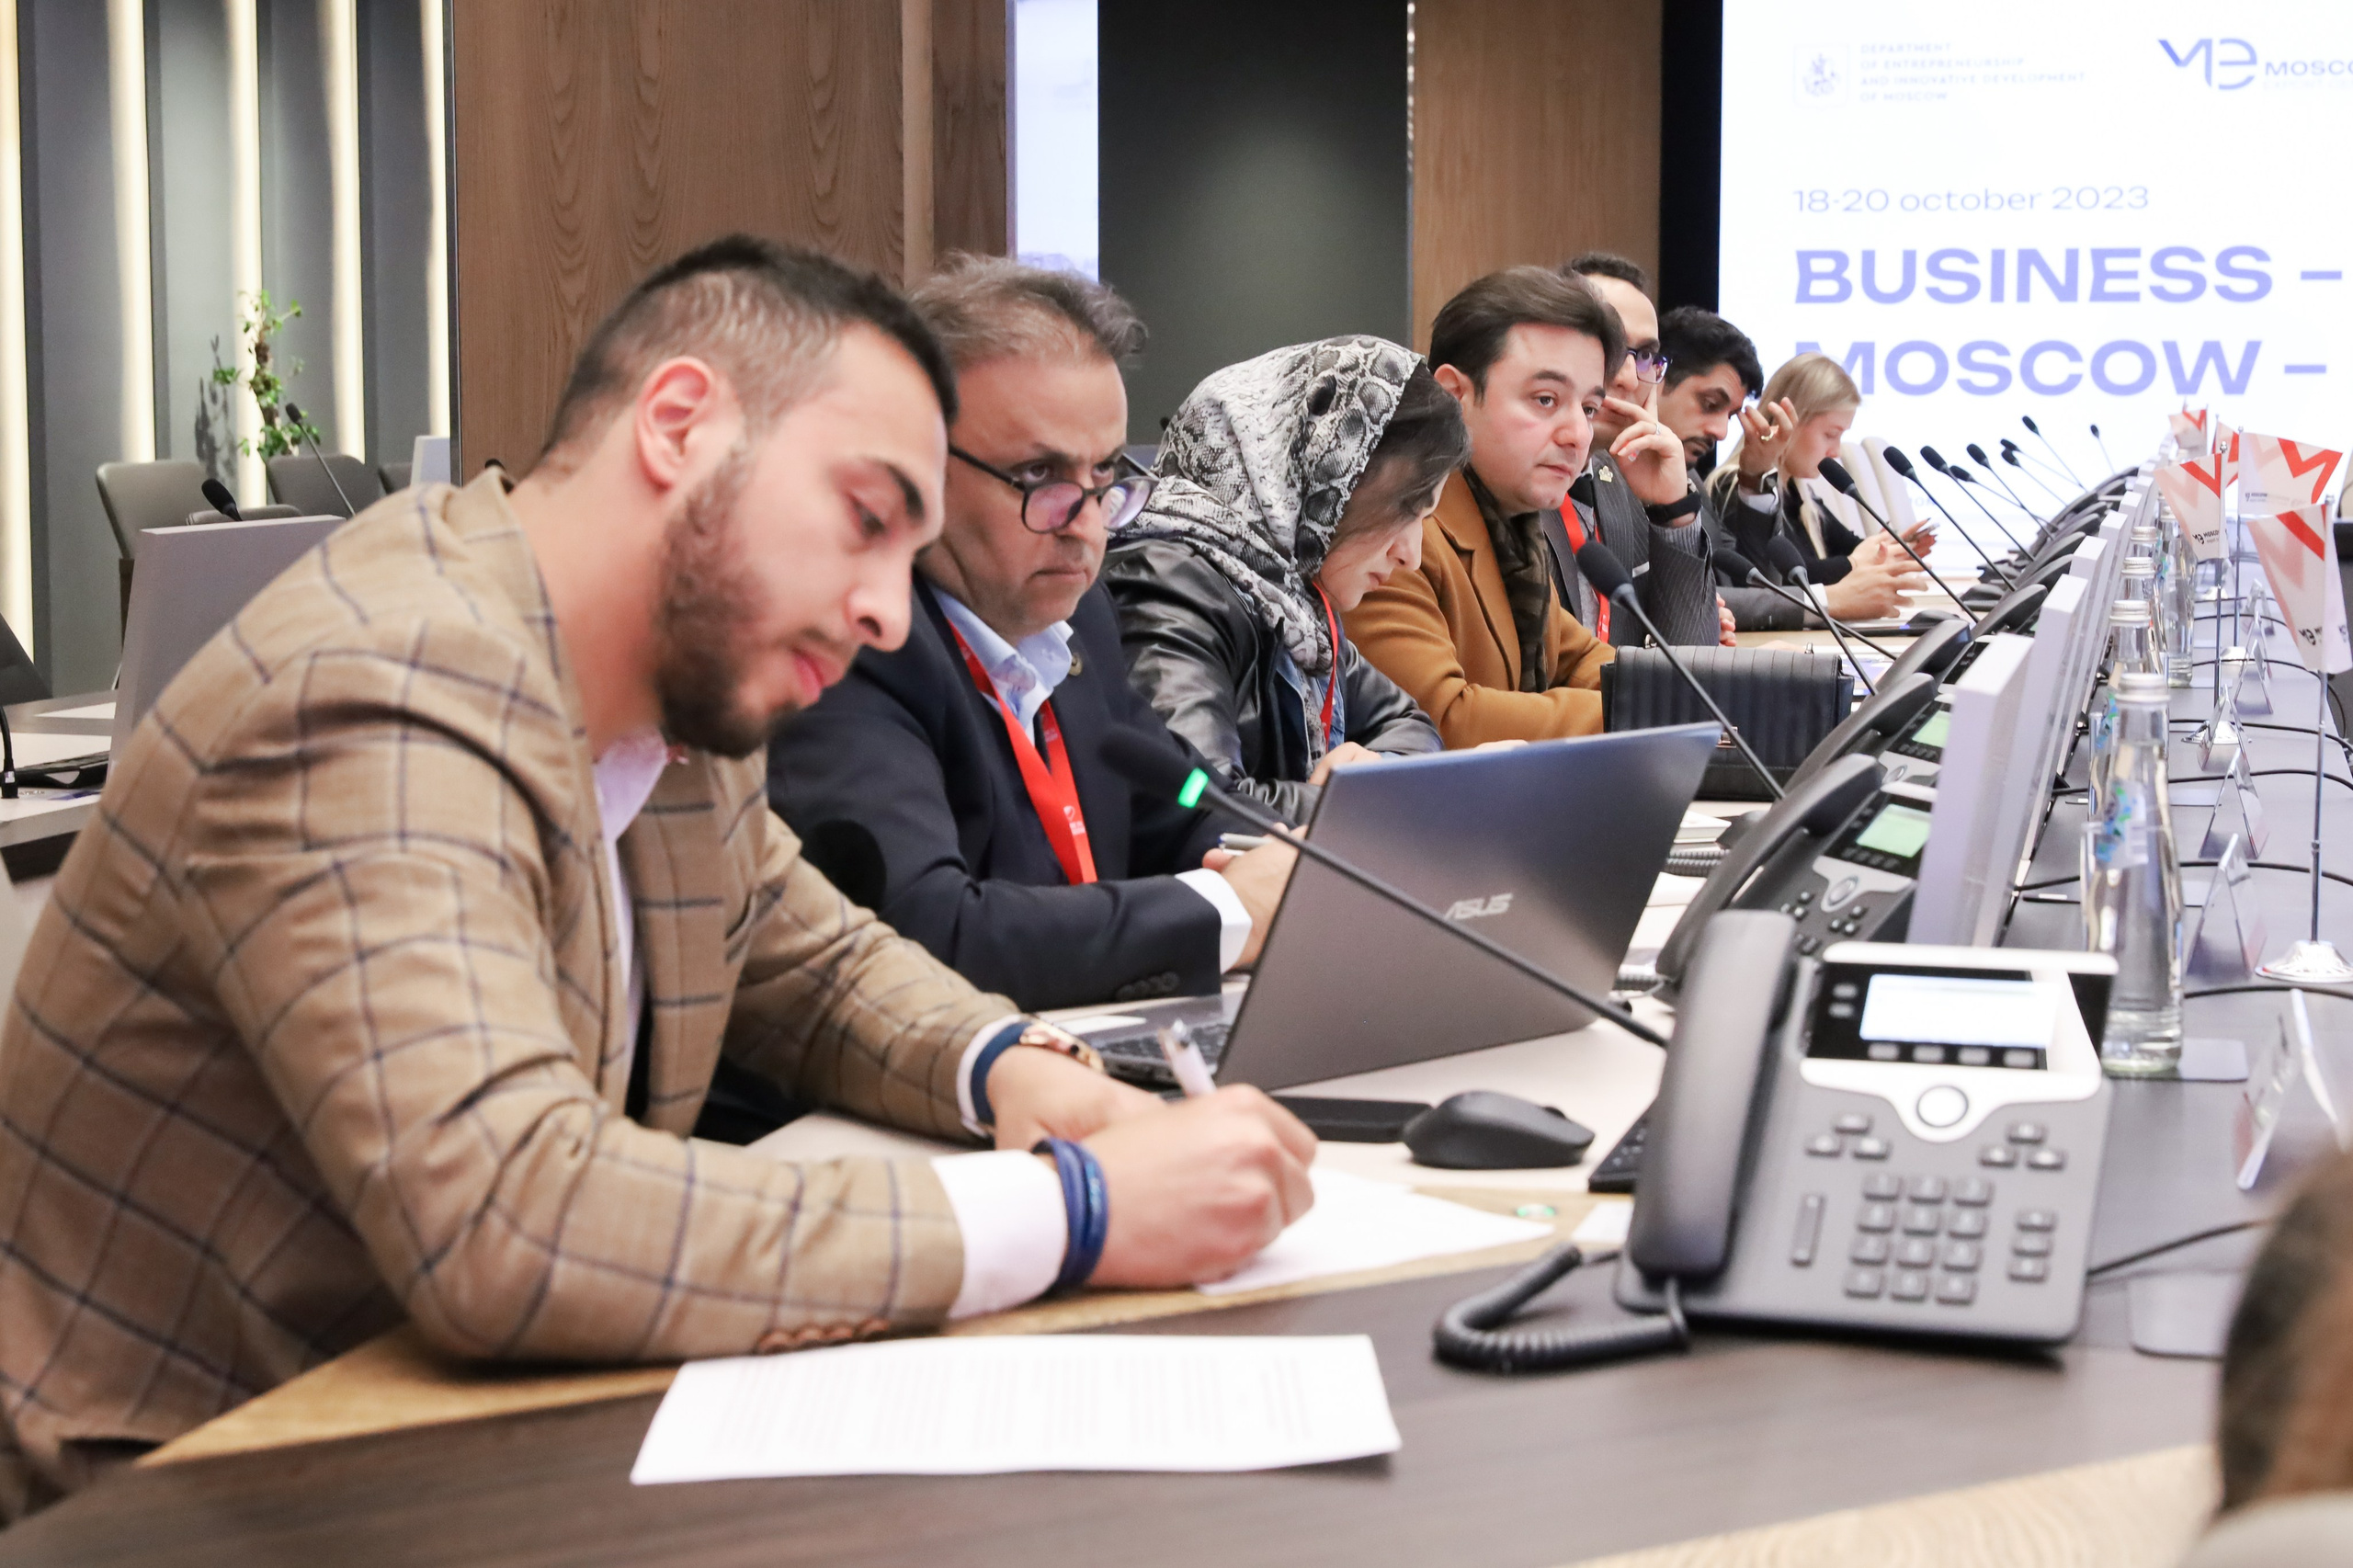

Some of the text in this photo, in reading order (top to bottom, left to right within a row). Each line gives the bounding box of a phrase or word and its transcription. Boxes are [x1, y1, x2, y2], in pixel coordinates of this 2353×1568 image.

[1859, 41, 1951, 54] DEPARTMENT
[1859, 59, 1877, 71] OF
[1859, 74, 1891, 86] AND
[1859, 90, 1948, 103] OF MOSCOW
[1899, 187, 2042, 212] october
[2052, 185, 2149, 210] 2023
[1794, 244, 2273, 305] BUSINESS
[1444, 892, 1514, 920] ASUS
